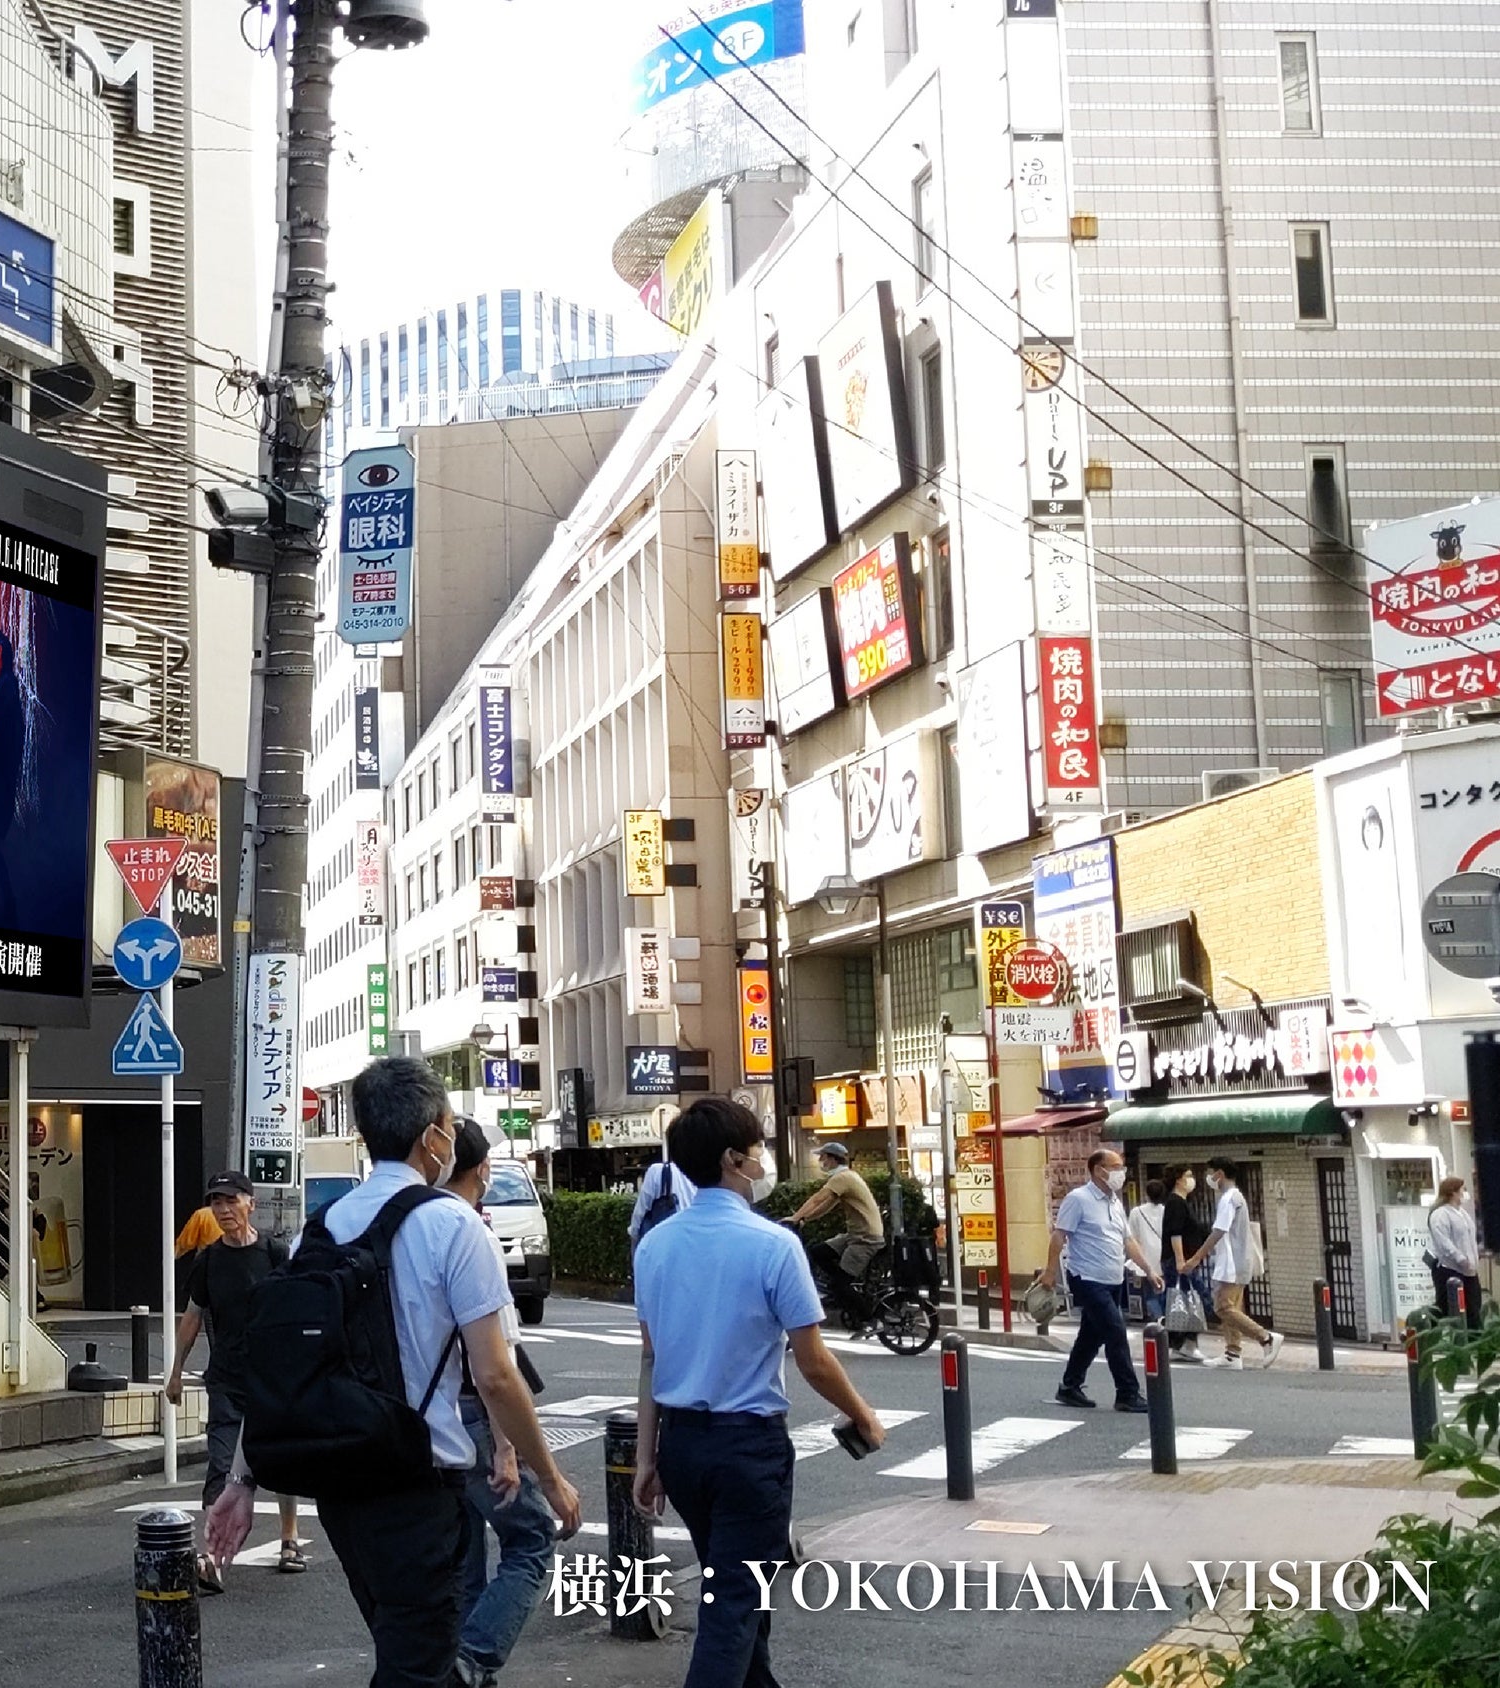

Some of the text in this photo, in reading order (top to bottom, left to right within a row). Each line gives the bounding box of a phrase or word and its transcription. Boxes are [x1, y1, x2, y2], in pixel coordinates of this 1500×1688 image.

[724, 30, 754, 56] 8F
[1047, 446, 1071, 498] UP
[349, 493, 407, 512] ベイシティ
[726, 471, 739, 537] ミライザカ
[1049, 502, 1064, 513] 3F
[348, 513, 406, 549] 眼科
[25, 544, 60, 585] RELEASE
[1048, 646, 1090, 780] 焼肉の和民
[486, 688, 505, 792] 富士コンタクト
[1065, 791, 1083, 803] 4F
[629, 814, 643, 824] 3F
[122, 844, 173, 866] 止まれ
[131, 867, 166, 883] STOP
[363, 915, 379, 925] 2F
[1010, 963, 1056, 985] 消火栓
[369, 969, 387, 1049] 村田歯科
[749, 1012, 769, 1056] 松屋
[262, 1027, 282, 1100] ナディア
[521, 1050, 536, 1060] 2F
[631, 1050, 674, 1079] 大戸屋
[249, 1137, 292, 1147] 316-1306
[261, 1170, 283, 1180] 1-2
[974, 1174, 992, 1185] UP
